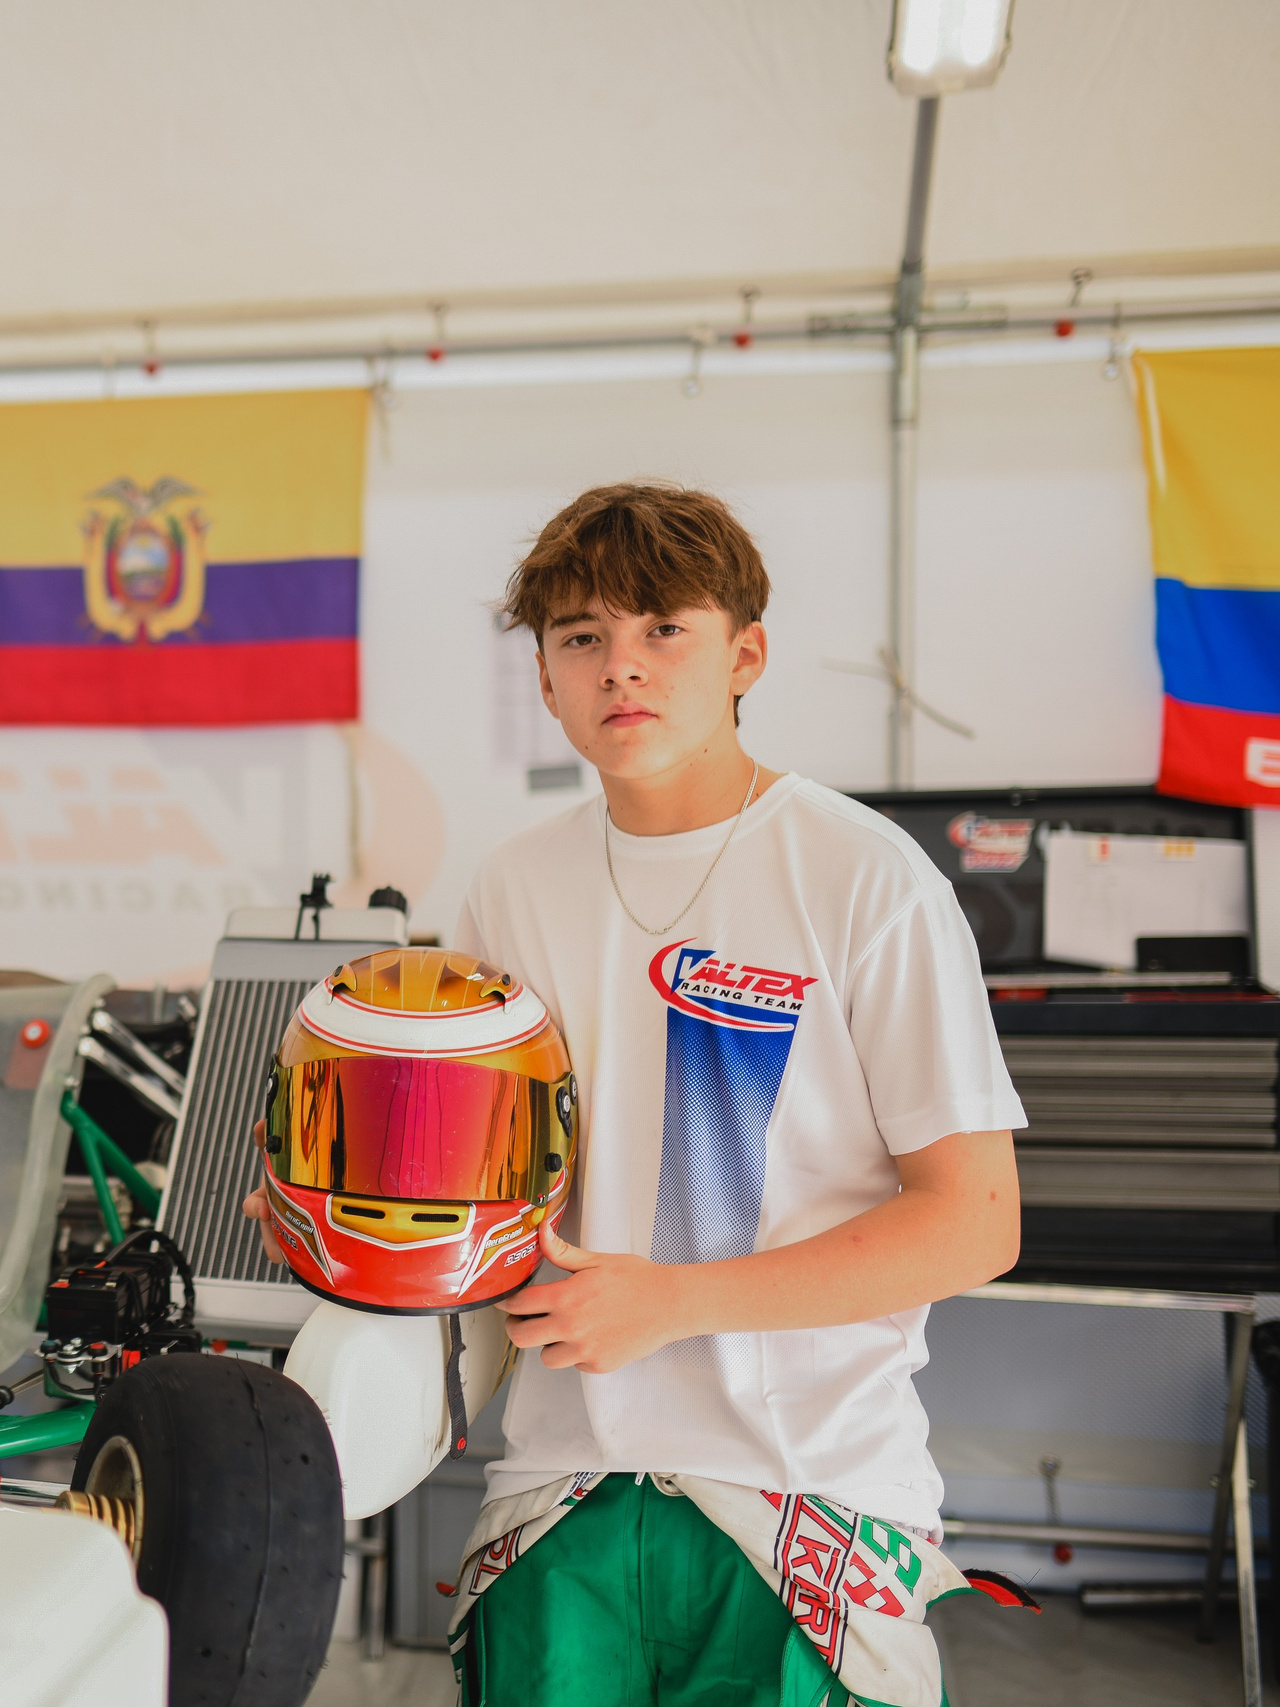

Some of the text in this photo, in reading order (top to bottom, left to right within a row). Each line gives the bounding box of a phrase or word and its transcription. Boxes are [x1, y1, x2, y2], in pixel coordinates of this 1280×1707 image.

[677, 952, 819, 1001] VALTEX
[681, 982, 803, 1011] RACING TEAM
